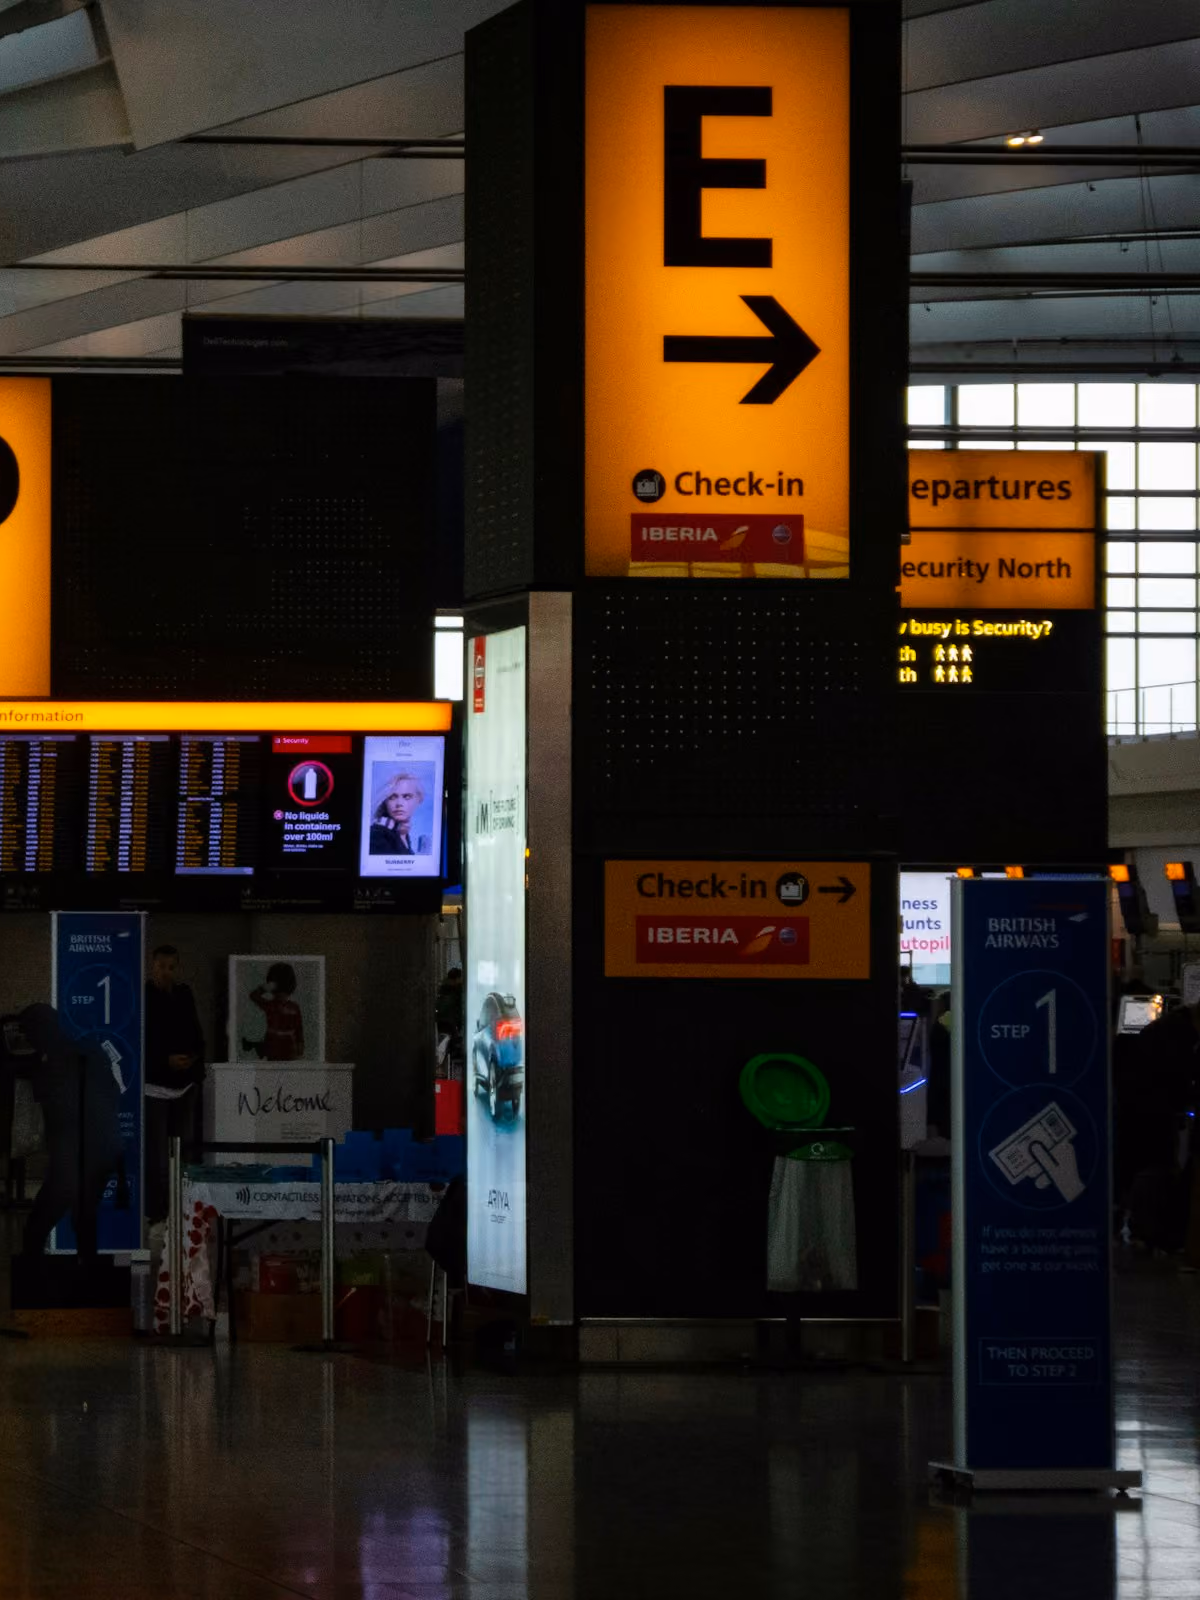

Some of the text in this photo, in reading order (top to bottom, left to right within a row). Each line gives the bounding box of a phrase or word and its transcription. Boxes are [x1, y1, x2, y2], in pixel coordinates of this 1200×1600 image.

[663, 85, 774, 268] E
[674, 470, 804, 497] Check-in
[910, 475, 1072, 507] epartures
[641, 526, 719, 542] IBERIA
[901, 556, 1072, 584] ecurity North
[909, 618, 953, 639] busy
[955, 618, 970, 636] is
[972, 618, 1053, 640] Security?
[284, 810, 329, 822] No liquids
[284, 821, 342, 831] in containers
[283, 832, 304, 842] over
[636, 872, 767, 899] Check-in
[987, 917, 1057, 933] BRITISH
[69, 934, 112, 943] BRITISH
[647, 926, 740, 945] IBERIA
[984, 933, 1060, 949] AIRWAYS
[68, 944, 113, 953] AIRWAYS
[71, 975, 111, 1025] STEP 1
[990, 987, 1057, 1075] STEP 1
[238, 1086, 335, 1116] Welcome
[253, 1192, 320, 1203] CONTACTLESS
[986, 1346, 1096, 1361] THEN PROCEED
[1007, 1364, 1029, 1377] TO
[1031, 1364, 1066, 1377] STEP
